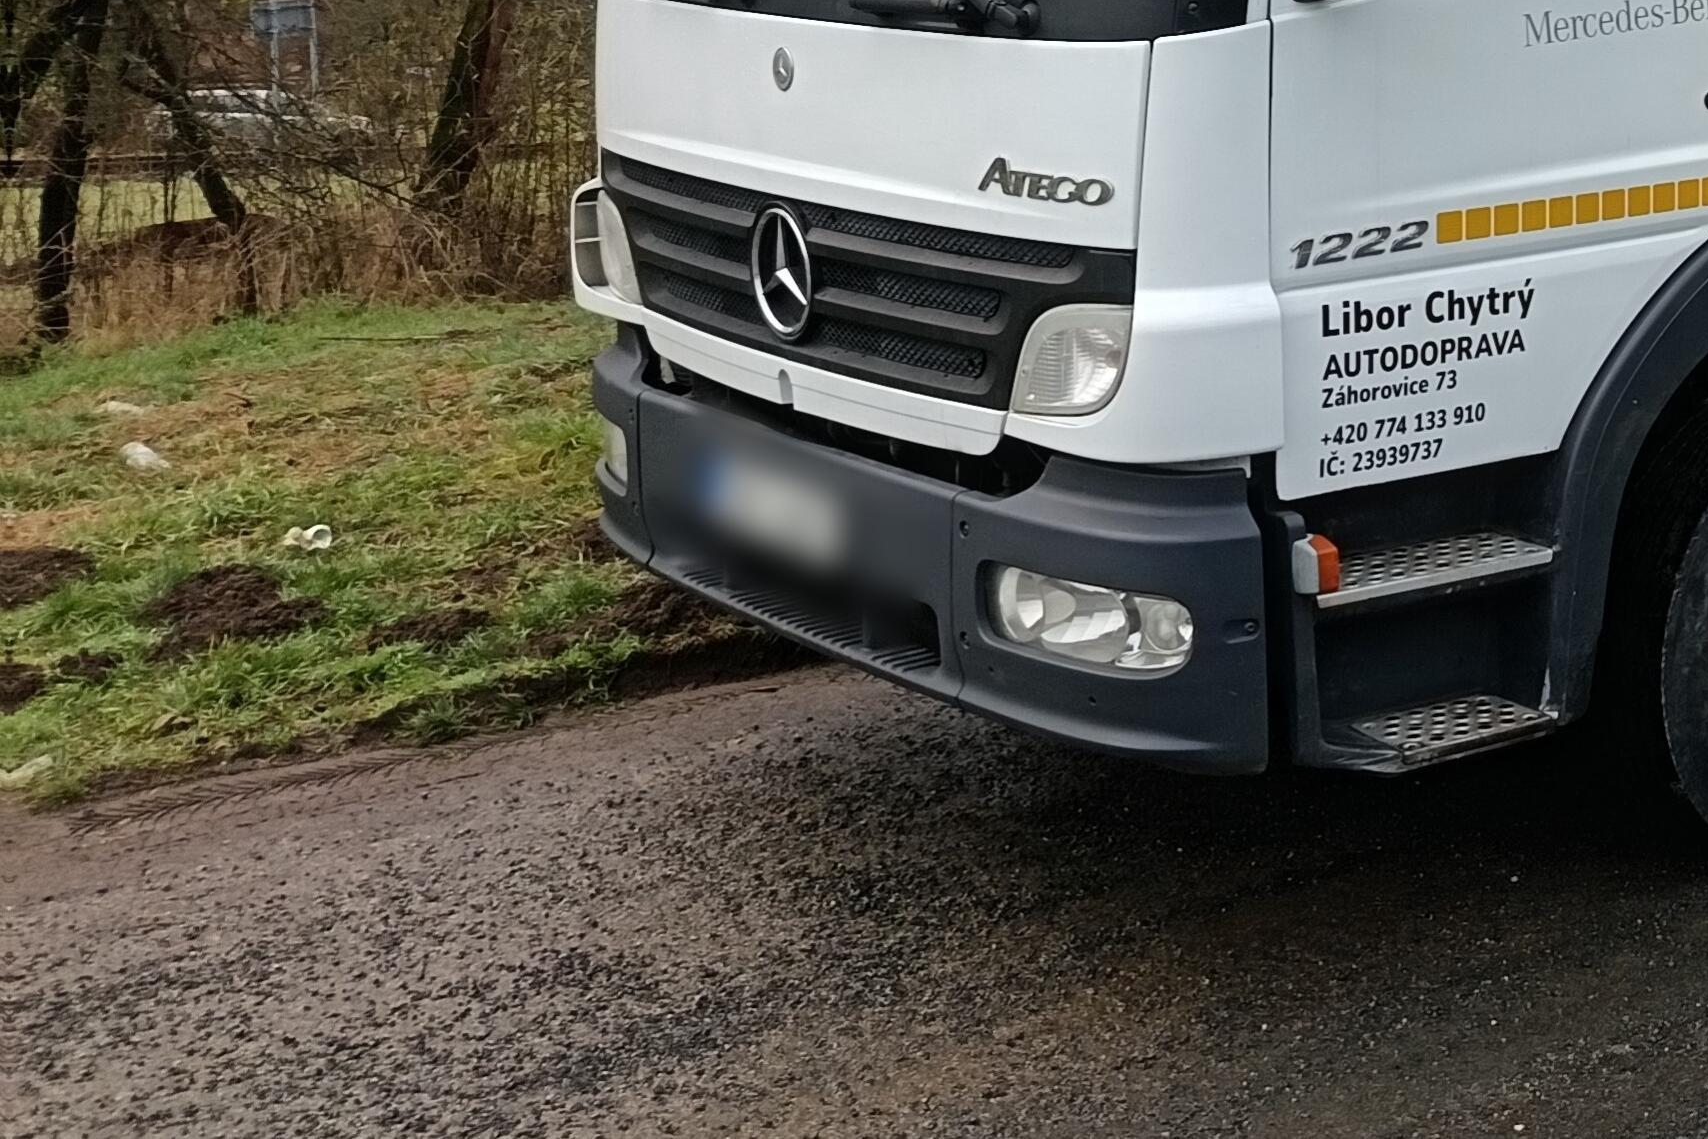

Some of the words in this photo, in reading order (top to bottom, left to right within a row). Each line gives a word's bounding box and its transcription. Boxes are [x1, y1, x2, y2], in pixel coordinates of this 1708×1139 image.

[1289, 220, 1430, 270] 1222
[1321, 300, 1411, 338] Libor
[1424, 278, 1535, 326] Chytrý
[1322, 328, 1526, 381] AUTODOPRAVA
[1321, 376, 1429, 409] Záhorovice
[1435, 369, 1458, 391] 73
[1320, 422, 1368, 447] +420
[1375, 415, 1407, 439] 774
[1414, 408, 1447, 434] 133
[1453, 402, 1486, 426] 910
[1318, 451, 1346, 478] IČ:
[1352, 438, 1444, 472] 23939737
